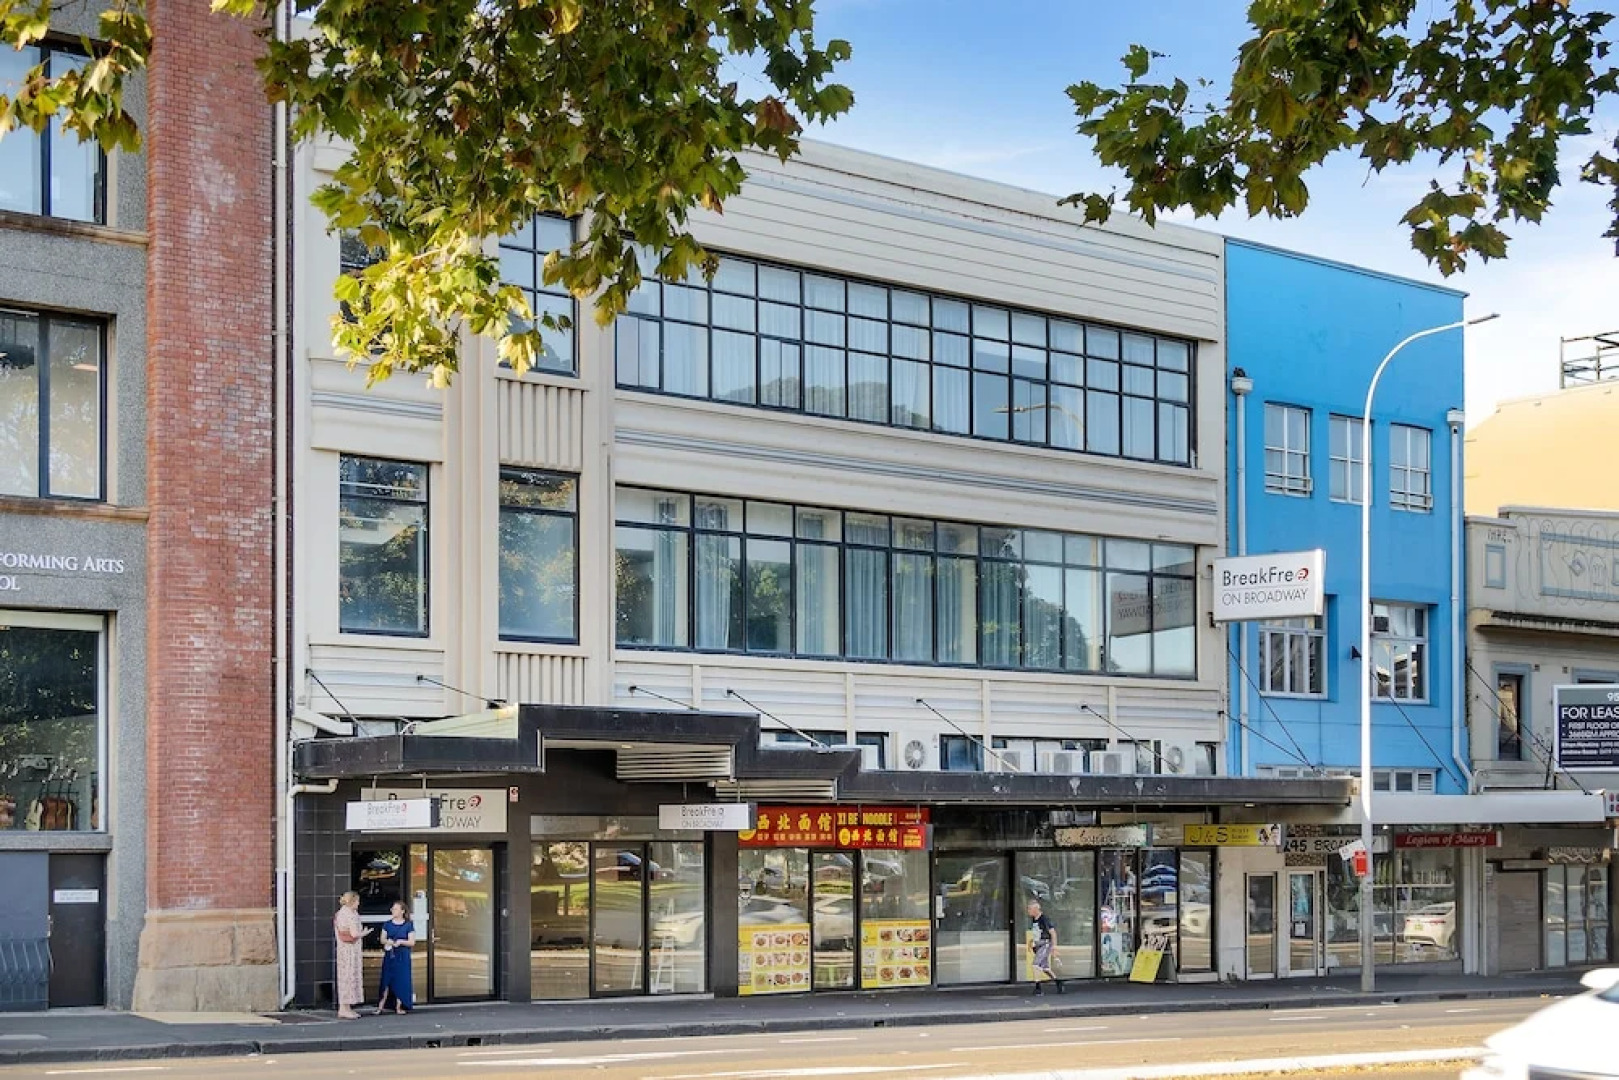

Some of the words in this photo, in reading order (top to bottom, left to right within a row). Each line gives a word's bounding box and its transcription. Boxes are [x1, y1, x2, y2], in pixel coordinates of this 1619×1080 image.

[83, 556, 124, 573] ARTS
[1222, 592, 1241, 606] ON
[1244, 588, 1309, 605] BROADWAY
[1562, 707, 1589, 719] FOR
[1405, 834, 1440, 847] Legion
[1442, 833, 1453, 847] of
[1455, 834, 1487, 846] Mary
